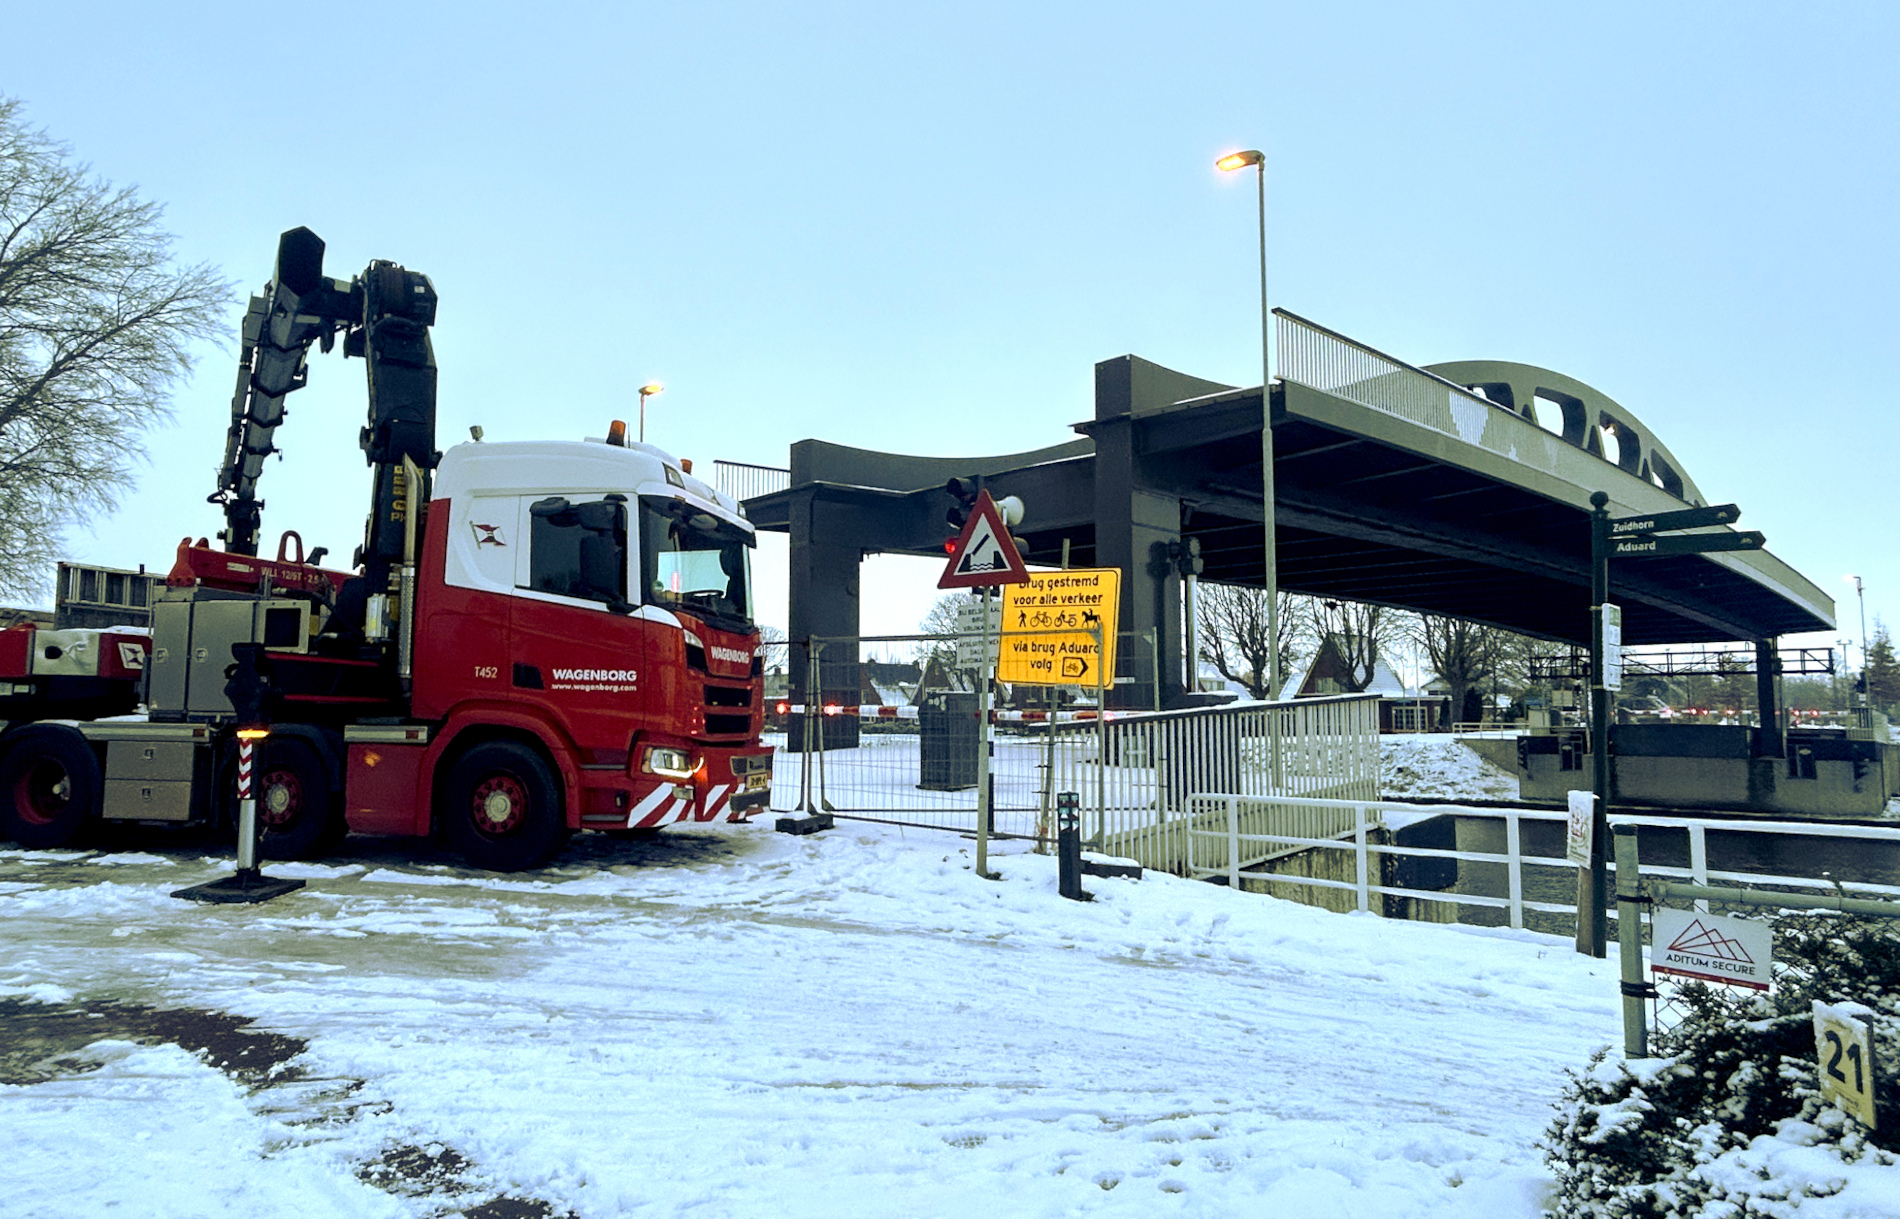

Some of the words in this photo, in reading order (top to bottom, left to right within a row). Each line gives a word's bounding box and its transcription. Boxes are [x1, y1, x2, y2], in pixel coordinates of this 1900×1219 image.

[1612, 521, 1655, 533] Zuidhorn
[1616, 541, 1657, 552] Aduard
[1047, 575, 1099, 591] gestremd
[1013, 595, 1037, 605] voor
[1039, 594, 1058, 604] alle
[1061, 593, 1103, 604] verkeer
[710, 646, 750, 664] WAGENBORG
[1013, 641, 1029, 652] via
[1031, 641, 1056, 656] brug
[1030, 658, 1052, 672] volg
[474, 666, 498, 678] T452
[551, 668, 638, 682] WAGENBORG
[551, 683, 638, 693] www.wagenborg.com
[1665, 953, 1709, 968] ADITUM
[1711, 960, 1757, 976] SECURE
[1824, 1029, 1864, 1095] 21
